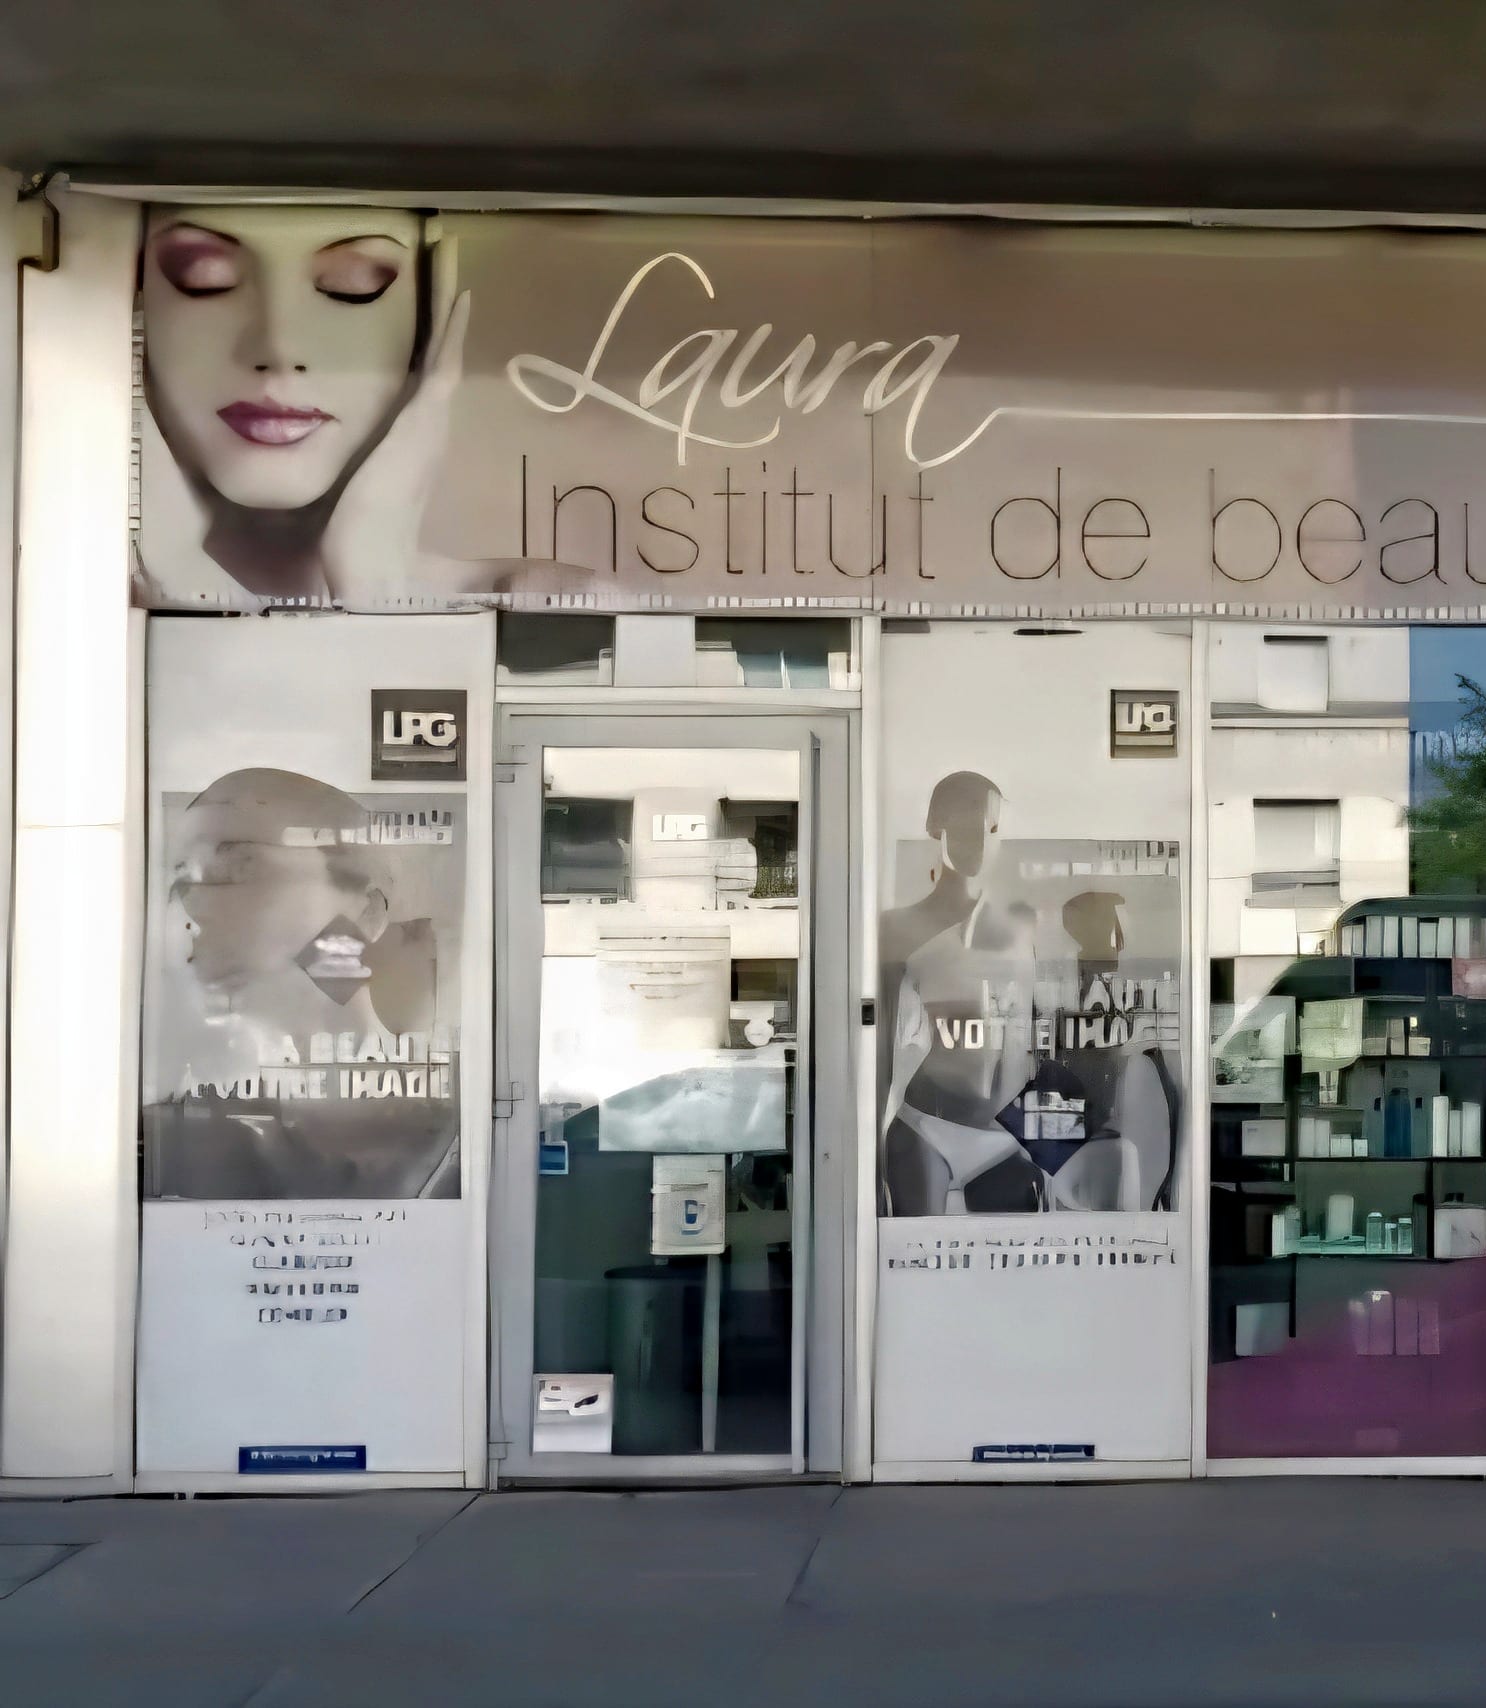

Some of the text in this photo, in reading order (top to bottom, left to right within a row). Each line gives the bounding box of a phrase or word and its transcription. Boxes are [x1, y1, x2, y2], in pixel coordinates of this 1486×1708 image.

[507, 252, 1000, 471] Laura
[521, 454, 935, 580] Institut
[990, 466, 1151, 580] de
